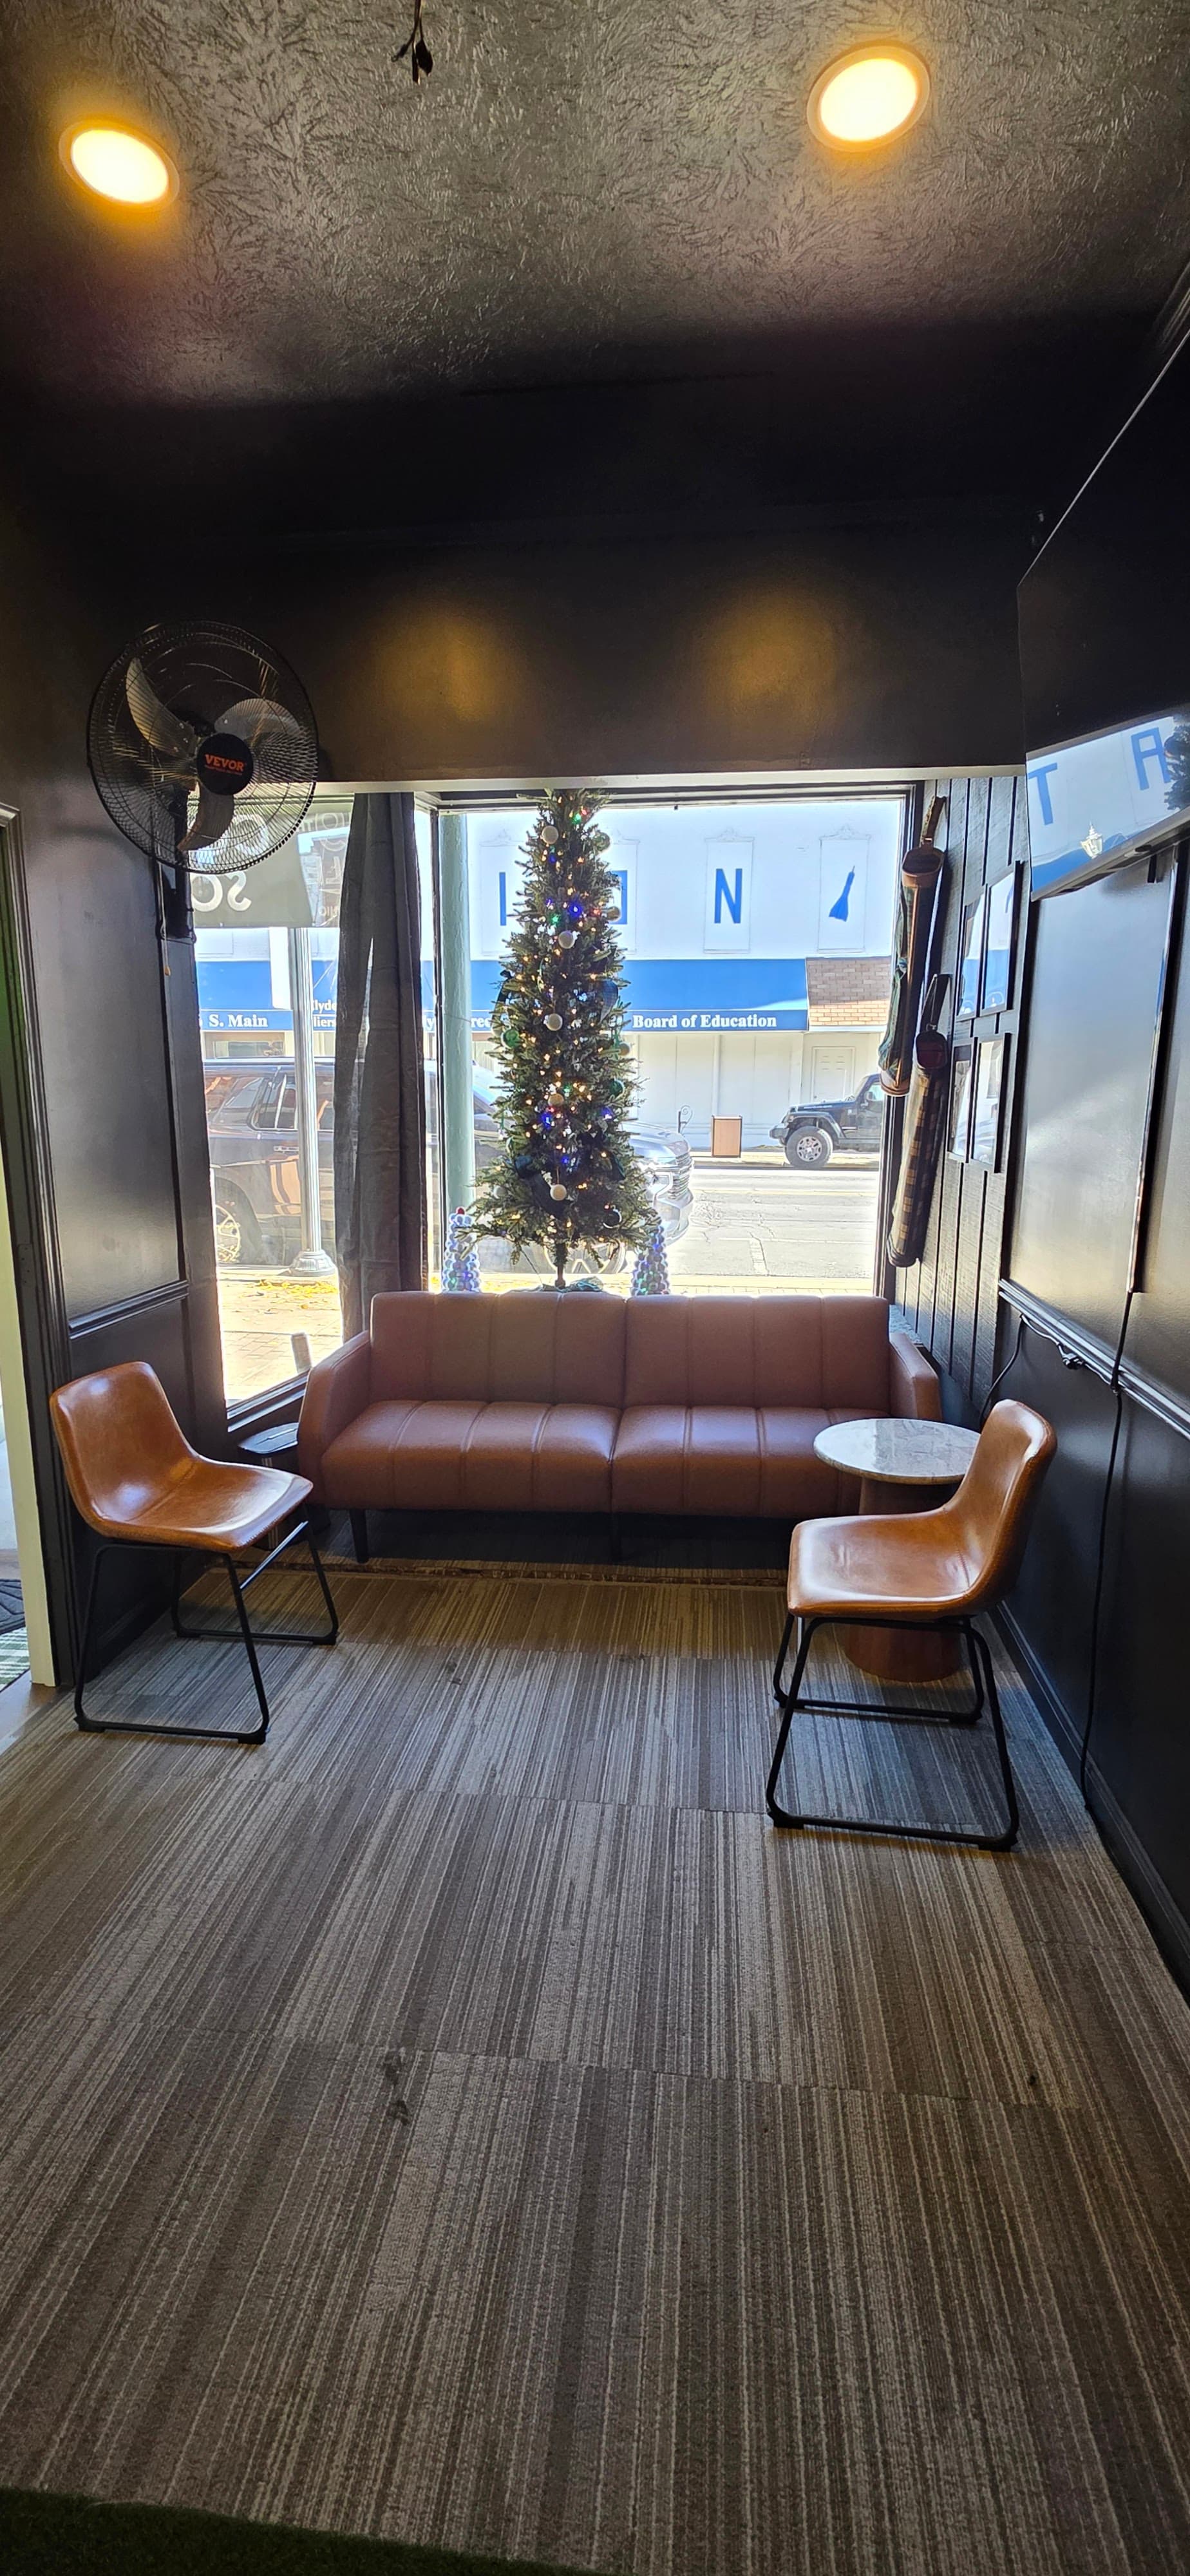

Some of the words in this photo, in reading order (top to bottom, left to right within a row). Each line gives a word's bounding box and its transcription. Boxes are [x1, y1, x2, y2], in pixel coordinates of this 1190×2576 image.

[205, 753, 244, 772] VEVOR
[714, 868, 742, 923] N
[209, 1014, 225, 1027] S.
[228, 1014, 268, 1027] Main
[632, 1014, 677, 1028] Board
[681, 1014, 696, 1028] of
[700, 1014, 777, 1028] Education
